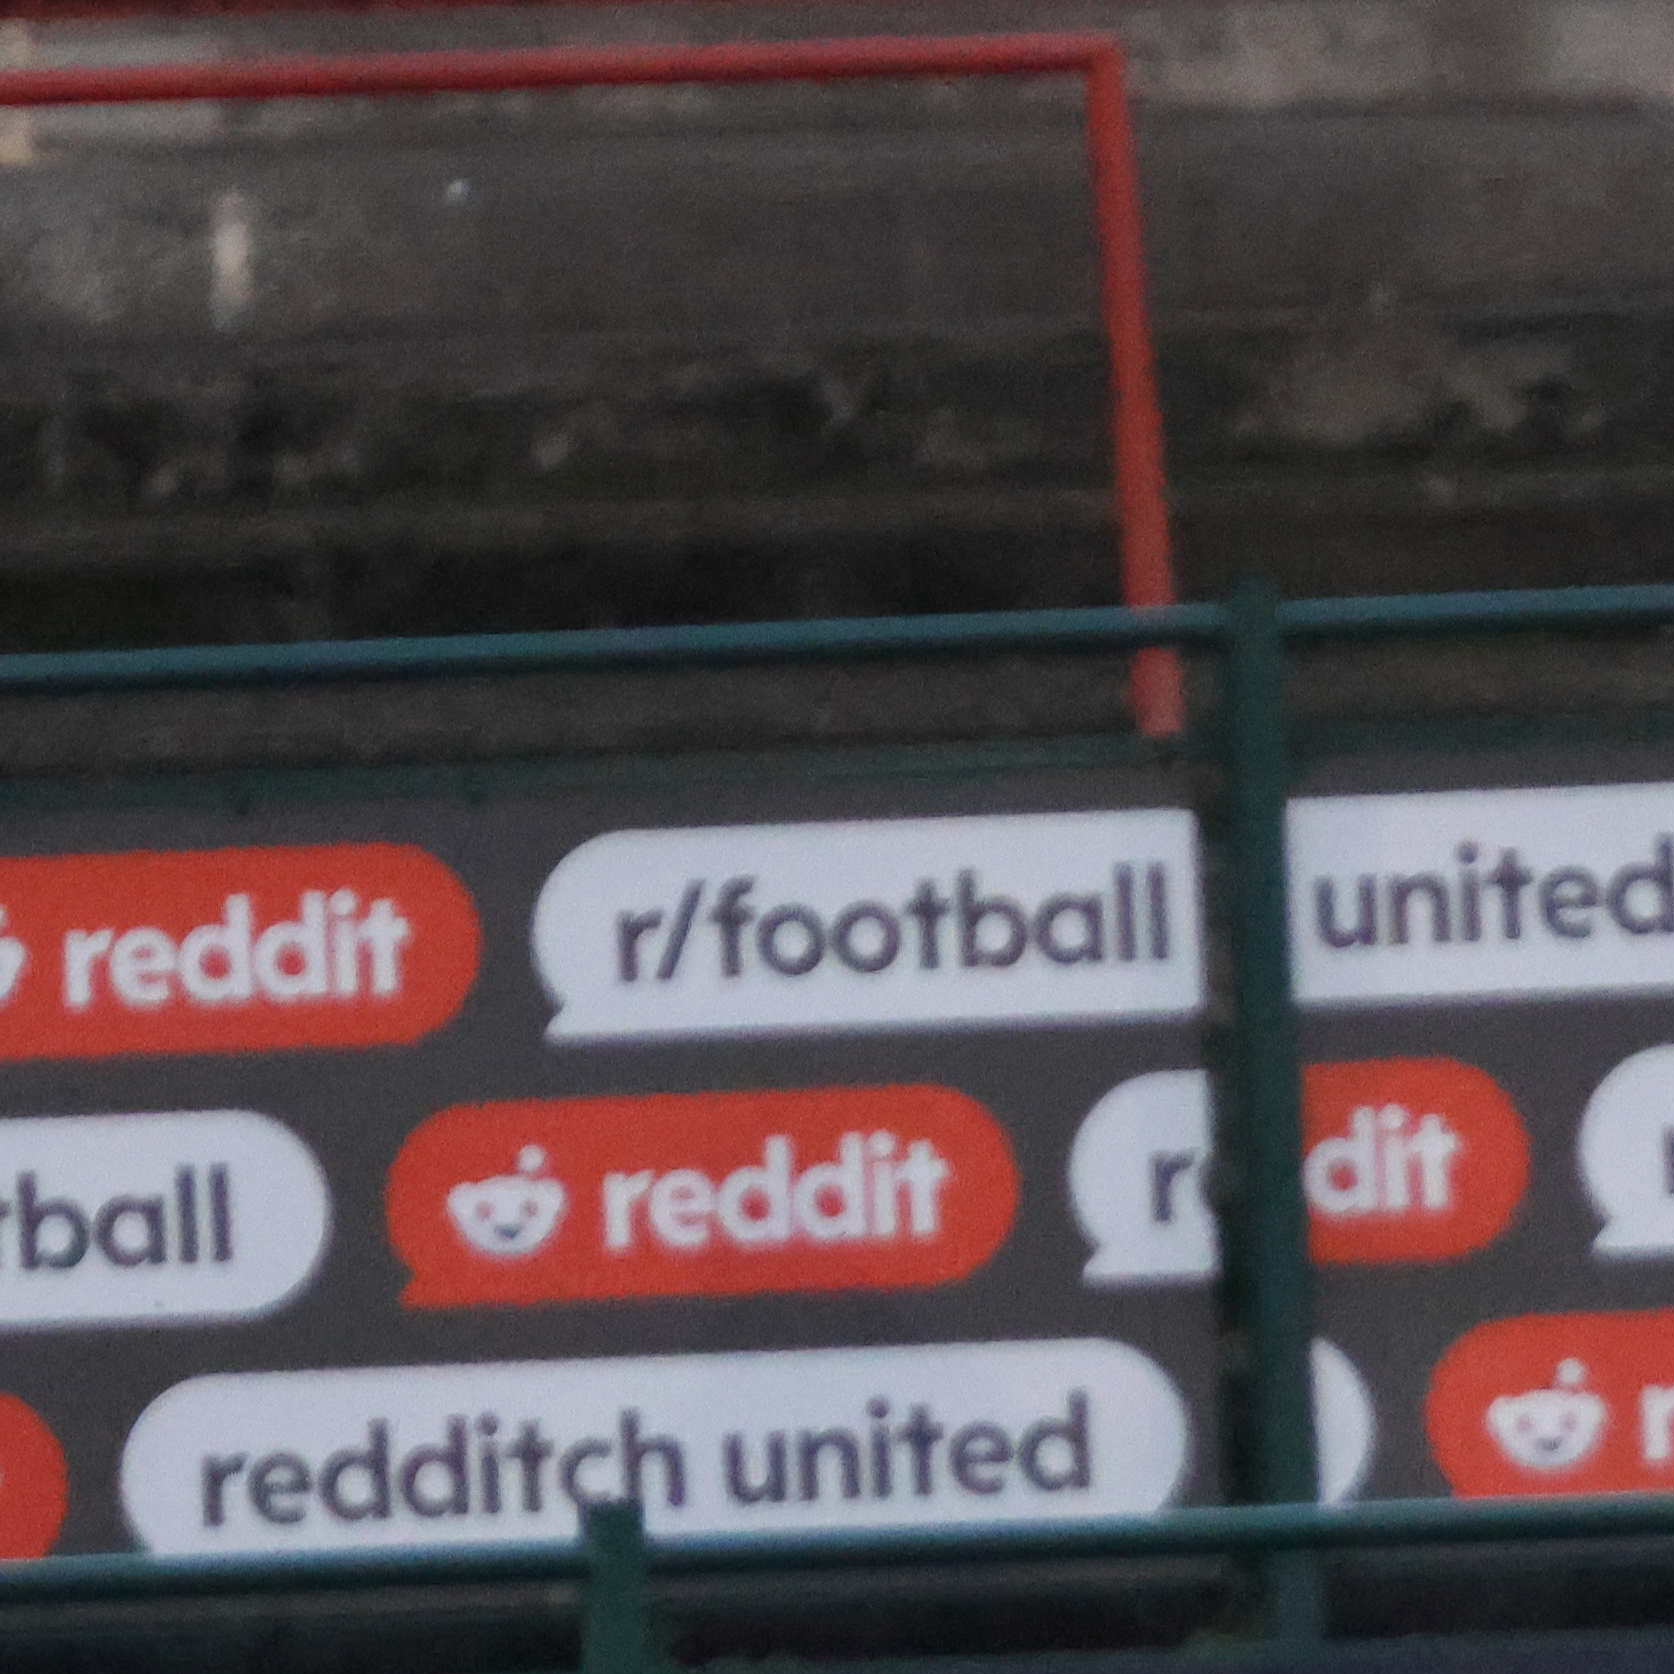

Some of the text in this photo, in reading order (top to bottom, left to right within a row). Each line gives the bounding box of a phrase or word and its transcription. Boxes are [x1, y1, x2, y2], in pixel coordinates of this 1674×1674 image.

[64, 888, 411, 1010] reddit
[617, 860, 1170, 985] r/football
[603, 1128, 952, 1256] reddit
[1304, 1105, 1459, 1216] dit
[204, 1389, 1091, 1528] redditch united
